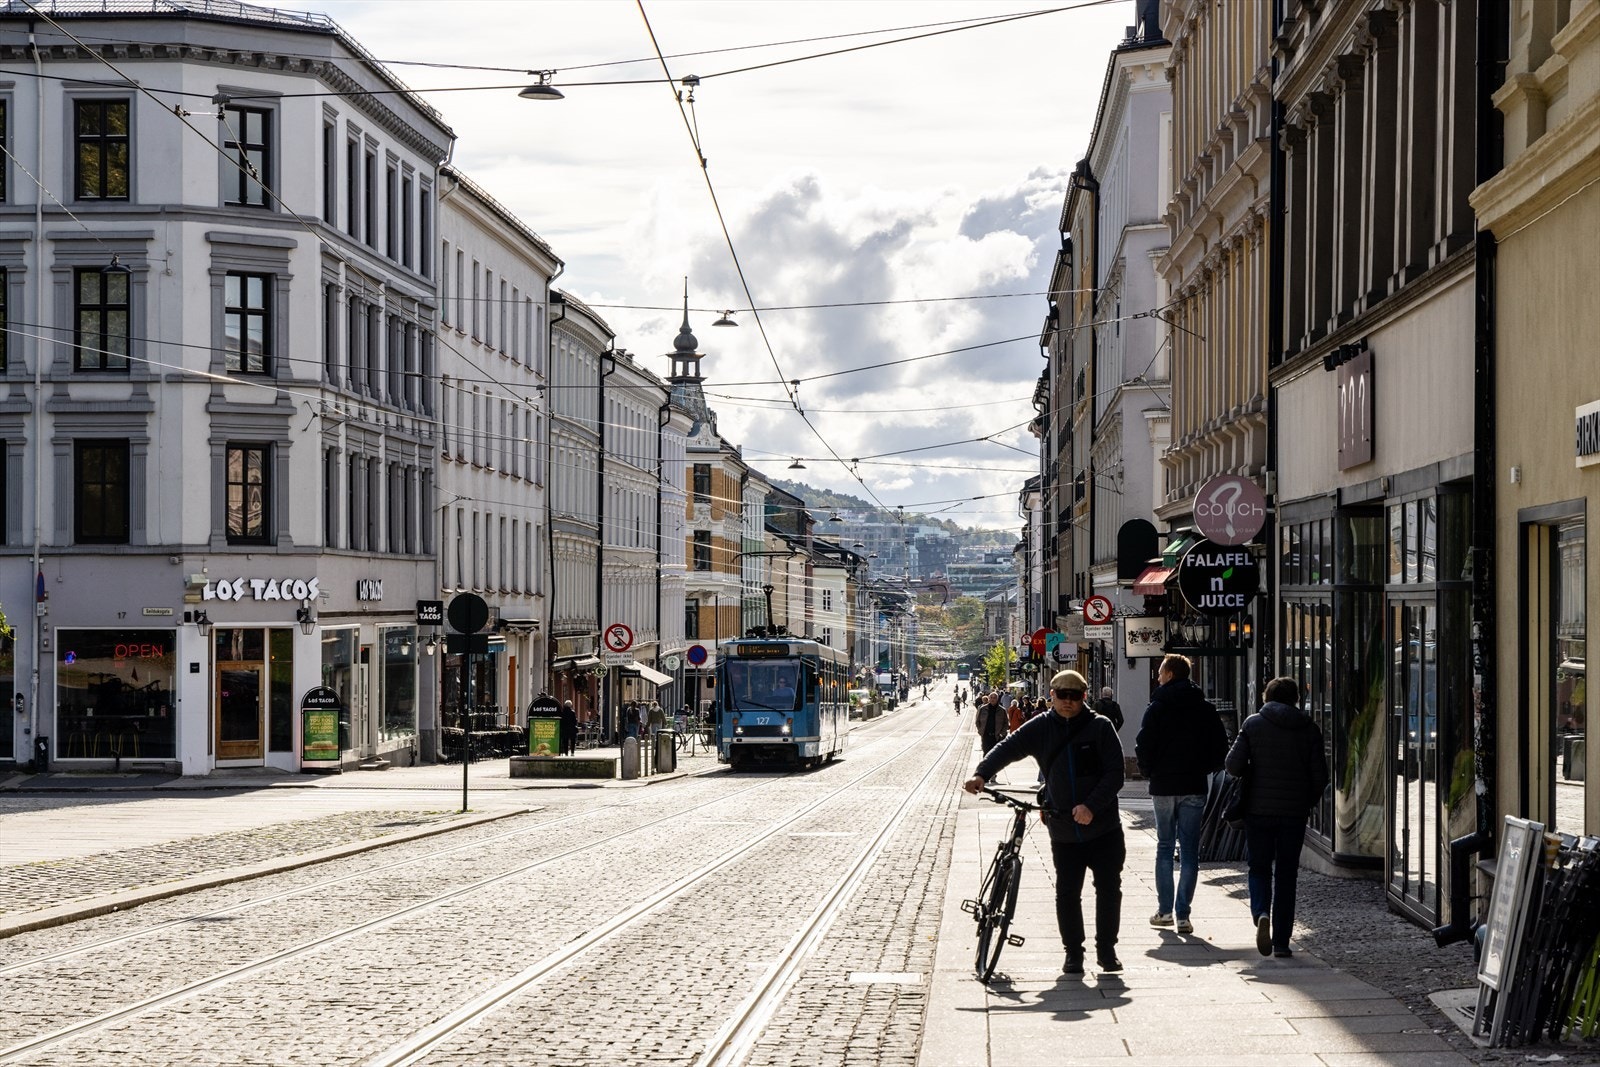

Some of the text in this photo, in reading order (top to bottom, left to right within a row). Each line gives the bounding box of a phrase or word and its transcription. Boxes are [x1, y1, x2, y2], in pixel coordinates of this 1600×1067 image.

[1575, 410, 1600, 456] BIRK
[1186, 553, 1253, 567] FALAFEL
[203, 577, 245, 601] LOS
[249, 577, 320, 601] TACOS
[359, 579, 383, 600] LOS TACOS
[1210, 576, 1224, 592] n
[1197, 594, 1245, 608] JUICE
[117, 611, 126, 619] 17
[115, 644, 163, 657] OPEN
[756, 717, 770, 725] 127
